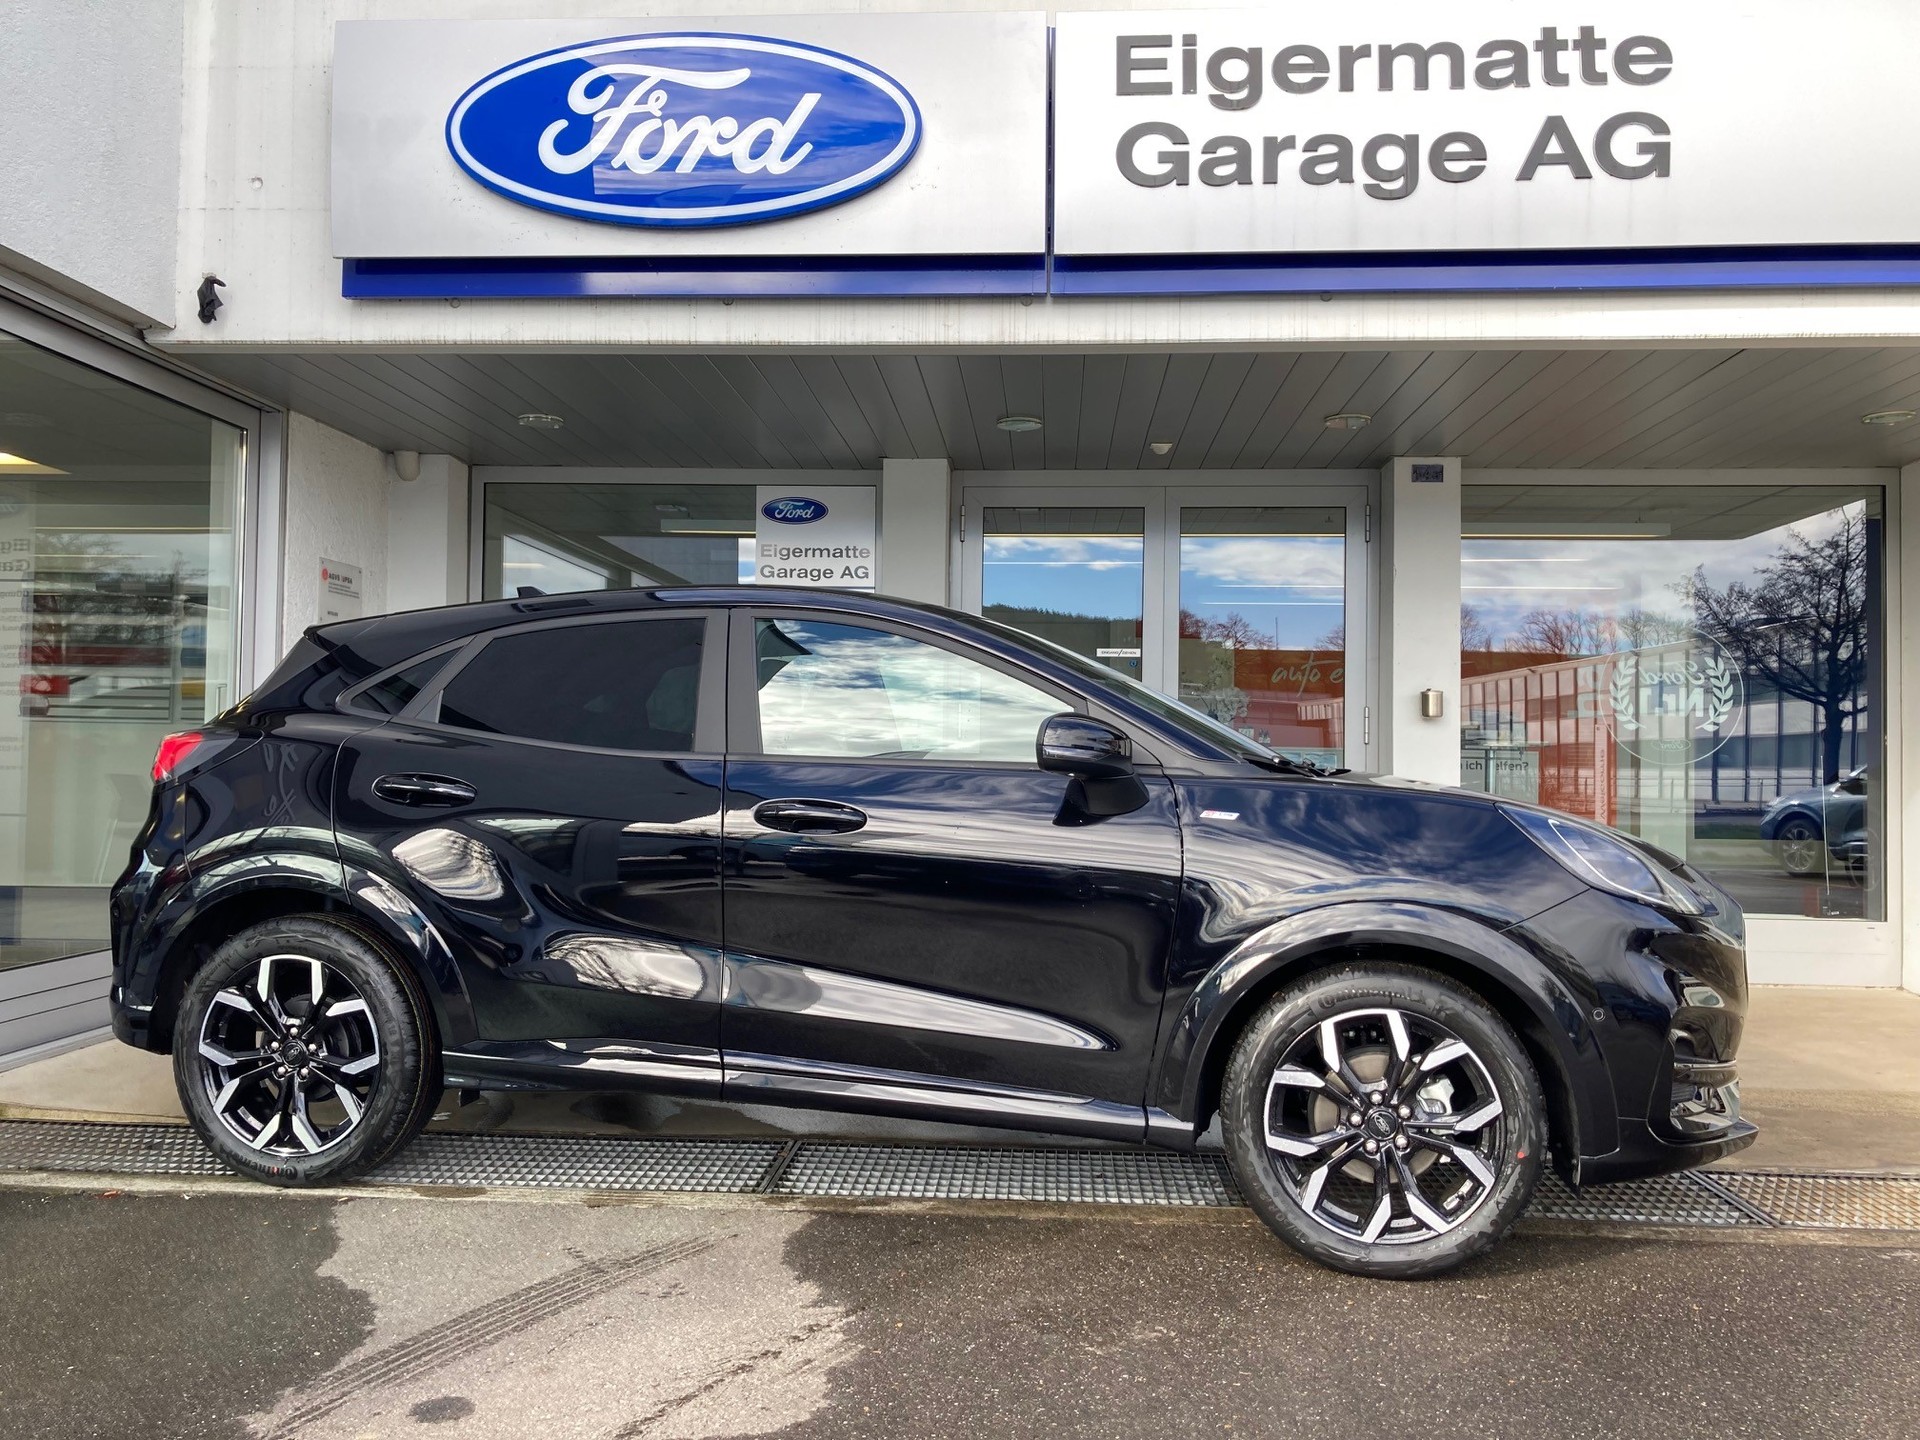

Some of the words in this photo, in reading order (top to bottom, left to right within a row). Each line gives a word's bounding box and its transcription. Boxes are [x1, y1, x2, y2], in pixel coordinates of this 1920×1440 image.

[1115, 26, 1673, 111] Eigermatte
[538, 64, 821, 176] Ford
[1115, 120, 1488, 200] Garage
[1516, 111, 1674, 181] AG
[775, 500, 815, 519] Ford
[760, 543, 871, 561] Eigermatte
[760, 564, 834, 581] Garage
[840, 565, 869, 579] AG
[1271, 652, 1338, 697] auto
[1465, 760, 1483, 770] ich
[1491, 761, 1529, 771] elfen?
